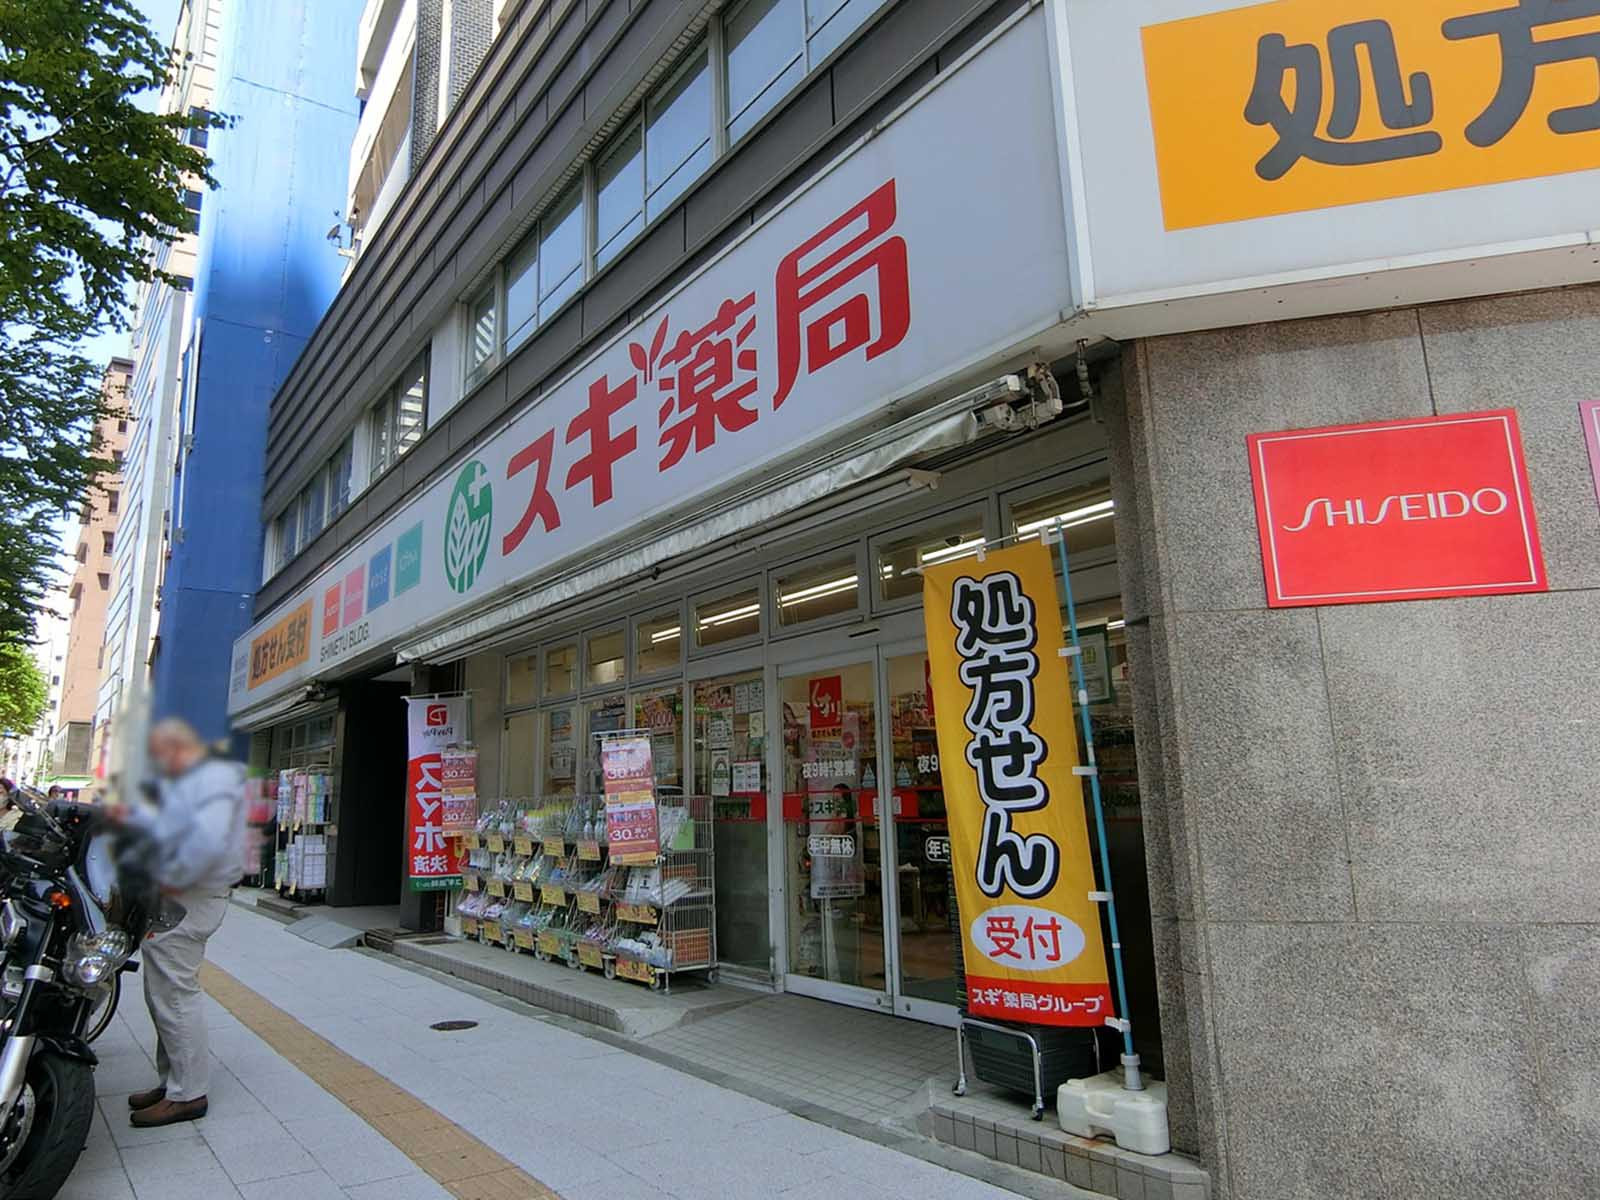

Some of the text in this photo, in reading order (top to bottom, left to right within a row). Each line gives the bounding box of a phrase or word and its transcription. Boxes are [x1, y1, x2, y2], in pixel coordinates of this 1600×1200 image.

[1244, 0, 1600, 181] 処方
[502, 178, 911, 557] スギ薬局
[1283, 487, 1508, 532] SHISEIDO
[951, 570, 1060, 898] 処方せん
[808, 837, 853, 854] 年中無休
[986, 916, 1062, 961] 受付
[972, 987, 1105, 1014] スギ薬局グループ
